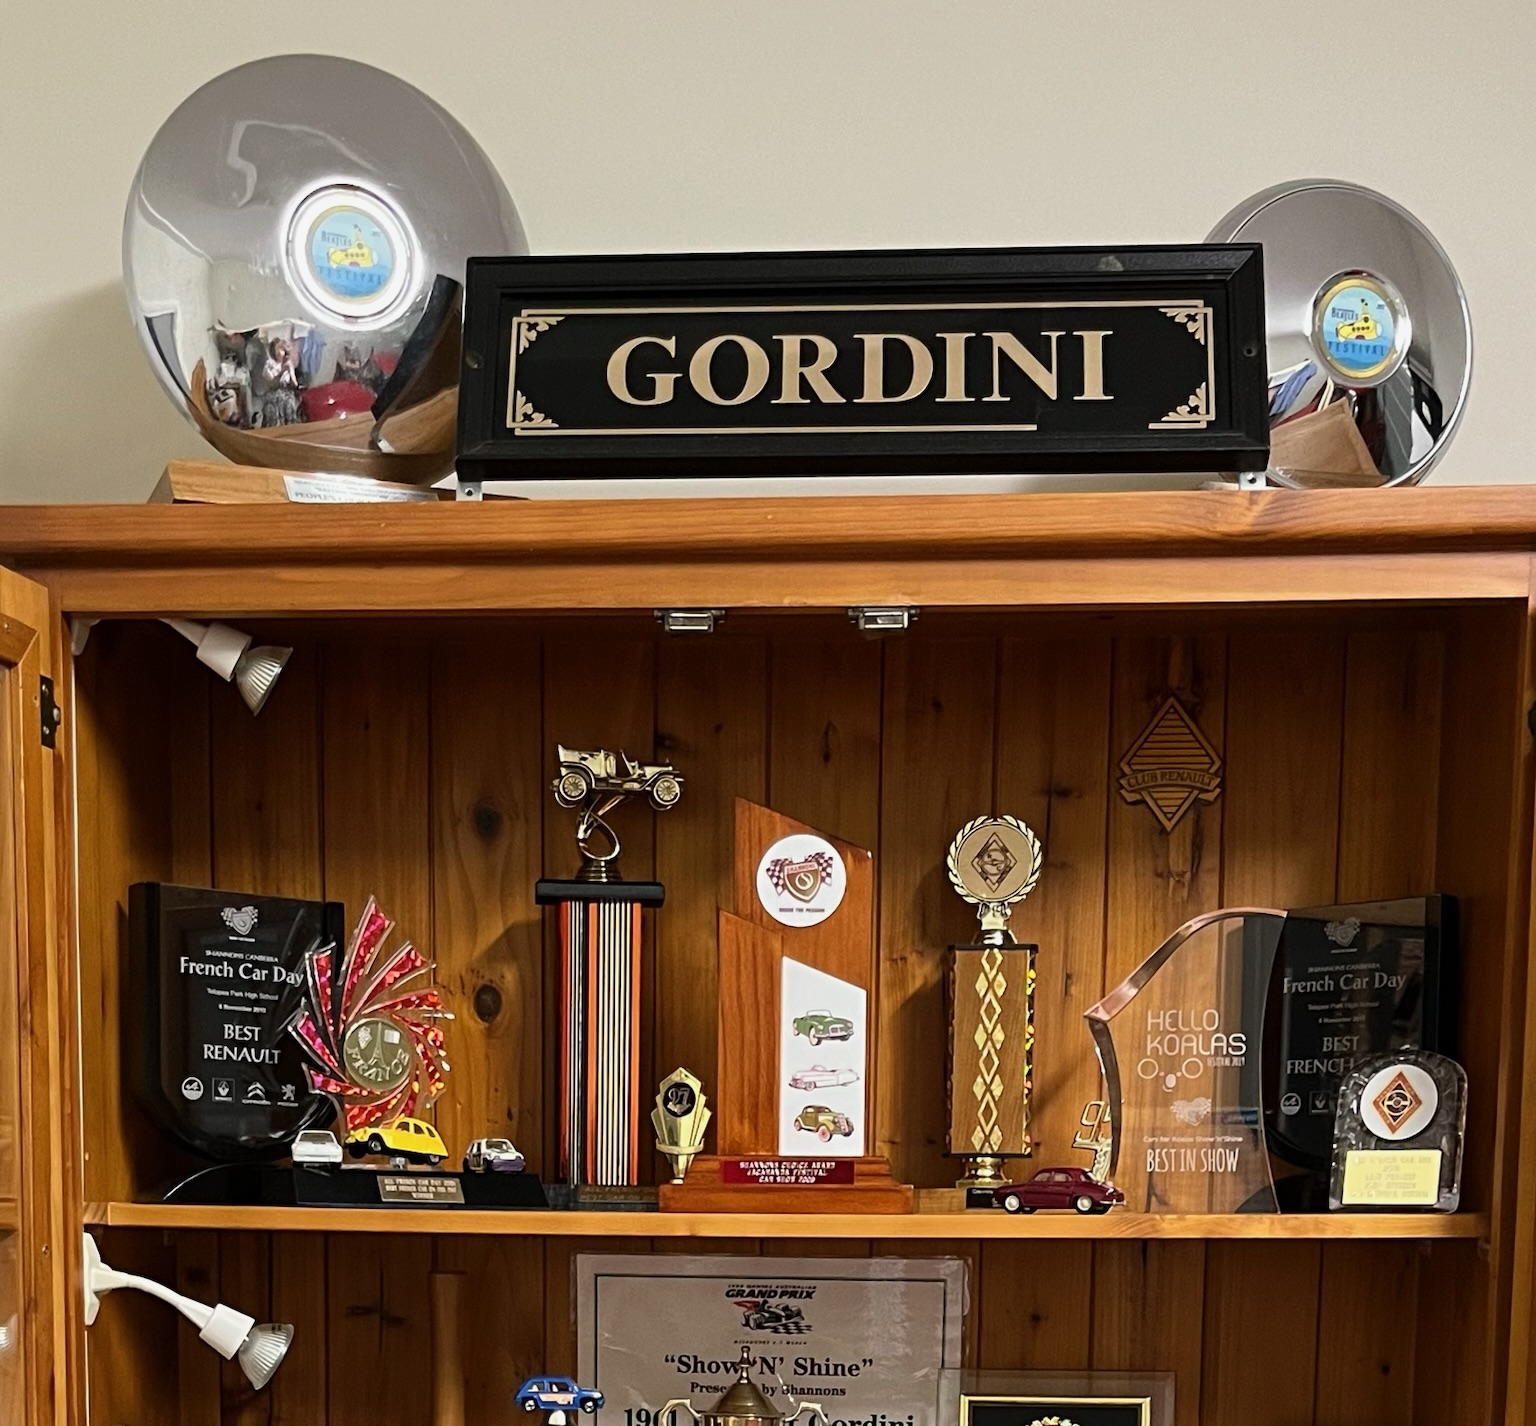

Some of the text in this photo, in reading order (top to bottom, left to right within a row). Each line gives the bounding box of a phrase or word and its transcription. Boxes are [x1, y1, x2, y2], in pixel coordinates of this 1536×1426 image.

[1328, 341, 1385, 357] FESTIVAL
[606, 330, 1115, 407] GORDINI
[1127, 770, 1215, 788] CLUB RENAULT
[180, 956, 304, 988] French Car Day
[1283, 971, 1407, 994] French Car Day
[1147, 1009, 1219, 1032] HELLO
[223, 1023, 262, 1042] BEST
[203, 1043, 282, 1065] RENAULT
[1147, 1033, 1247, 1056] KOALAS
[1321, 1035, 1360, 1053] BEST
[1286, 1057, 1355, 1075] FRENCH
[1146, 1147, 1240, 1173] BEST IN SHOW
[725, 1289, 817, 1300] GRAND PRIX
[761, 1382, 846, 1397] by Shannons
